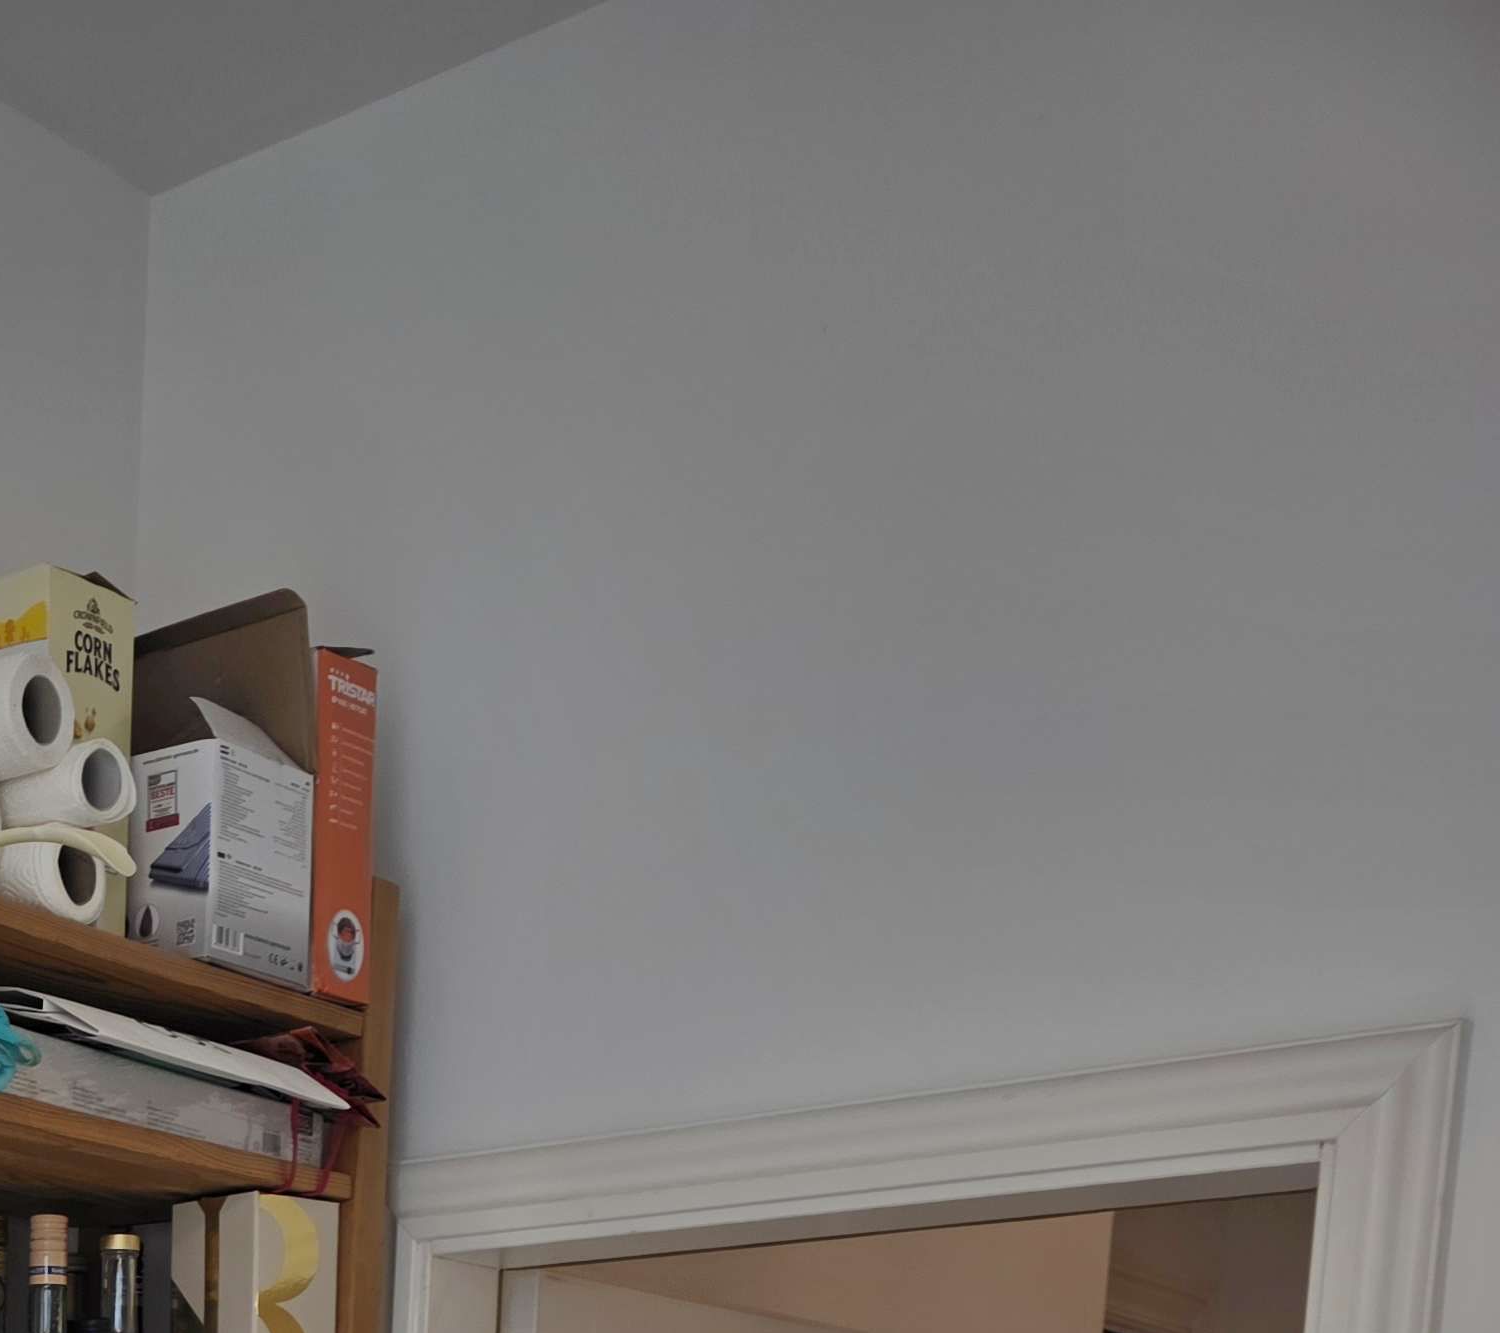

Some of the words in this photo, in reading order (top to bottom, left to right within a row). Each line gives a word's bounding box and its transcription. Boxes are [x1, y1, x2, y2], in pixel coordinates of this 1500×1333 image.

[74, 630, 112, 660] CORN
[66, 650, 120, 692] FLAKES
[328, 674, 375, 705] TRISTAR
